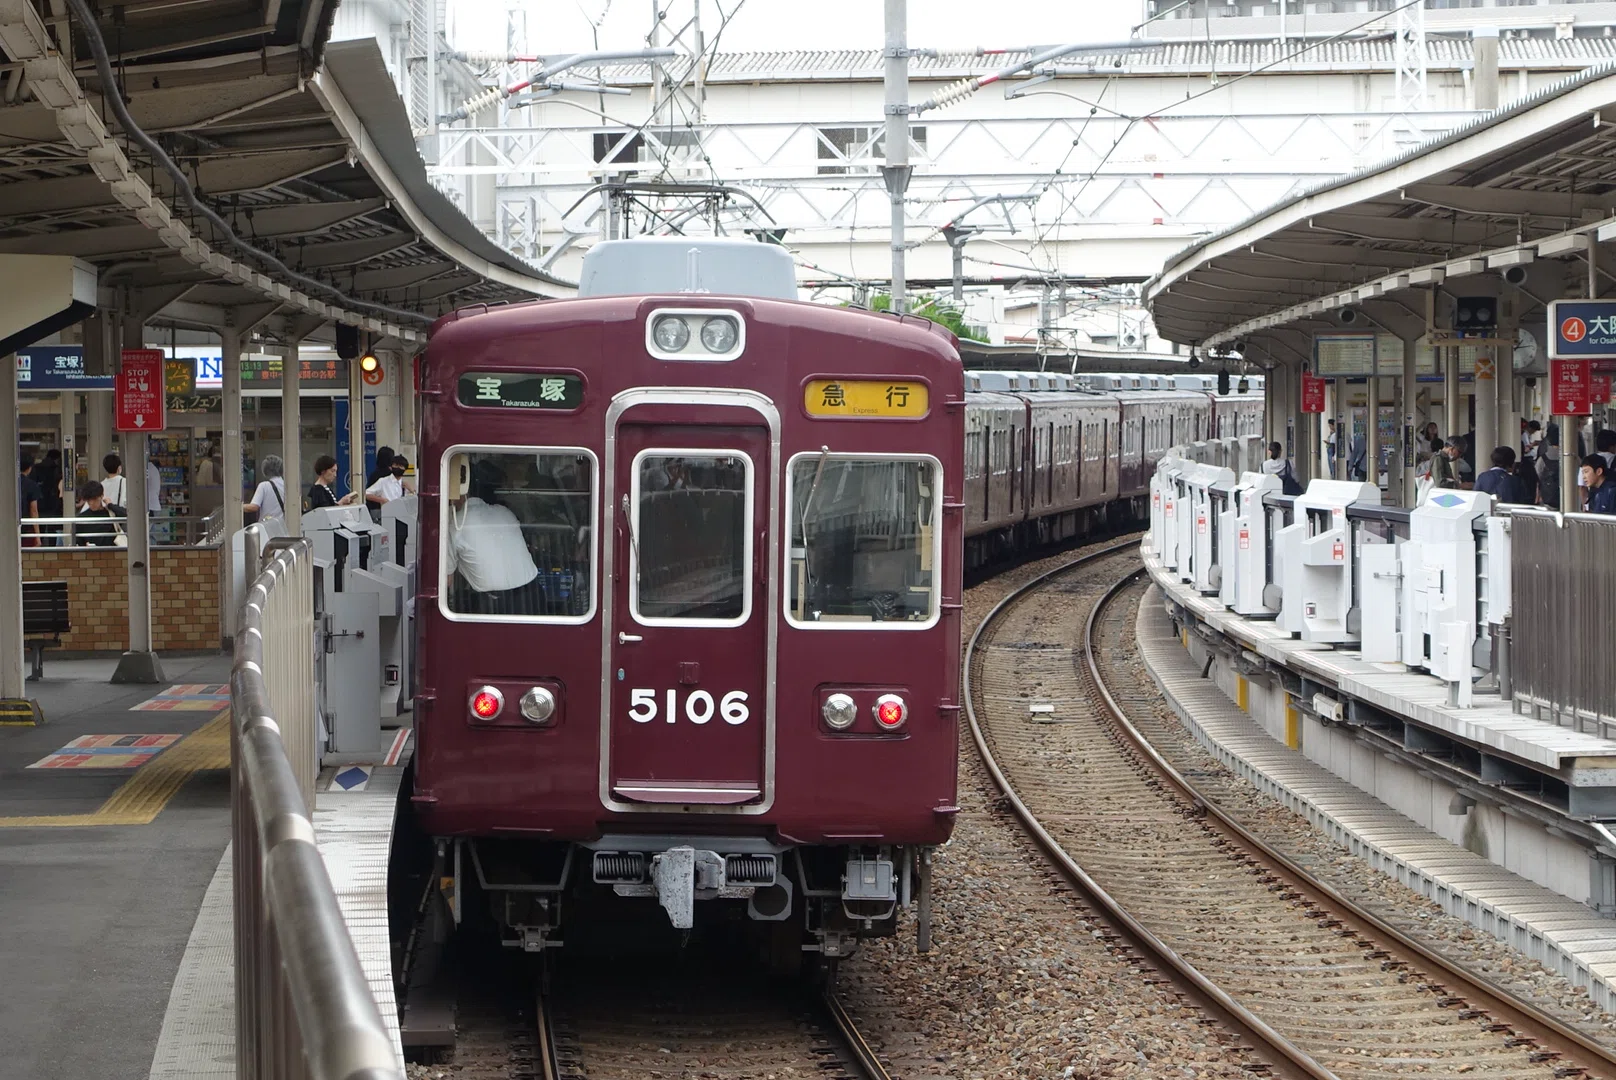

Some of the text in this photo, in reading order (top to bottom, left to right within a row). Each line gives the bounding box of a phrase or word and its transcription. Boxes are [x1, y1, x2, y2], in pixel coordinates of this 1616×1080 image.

[1567, 321, 1579, 338] 4
[127, 369, 149, 377] STOP
[1561, 363, 1580, 371] STOP
[476, 377, 565, 401] 宝塚
[822, 385, 910, 407] 急行
[501, 400, 540, 408] Takarazuka
[852, 407, 879, 415] Express
[628, 688, 750, 725] 5106
